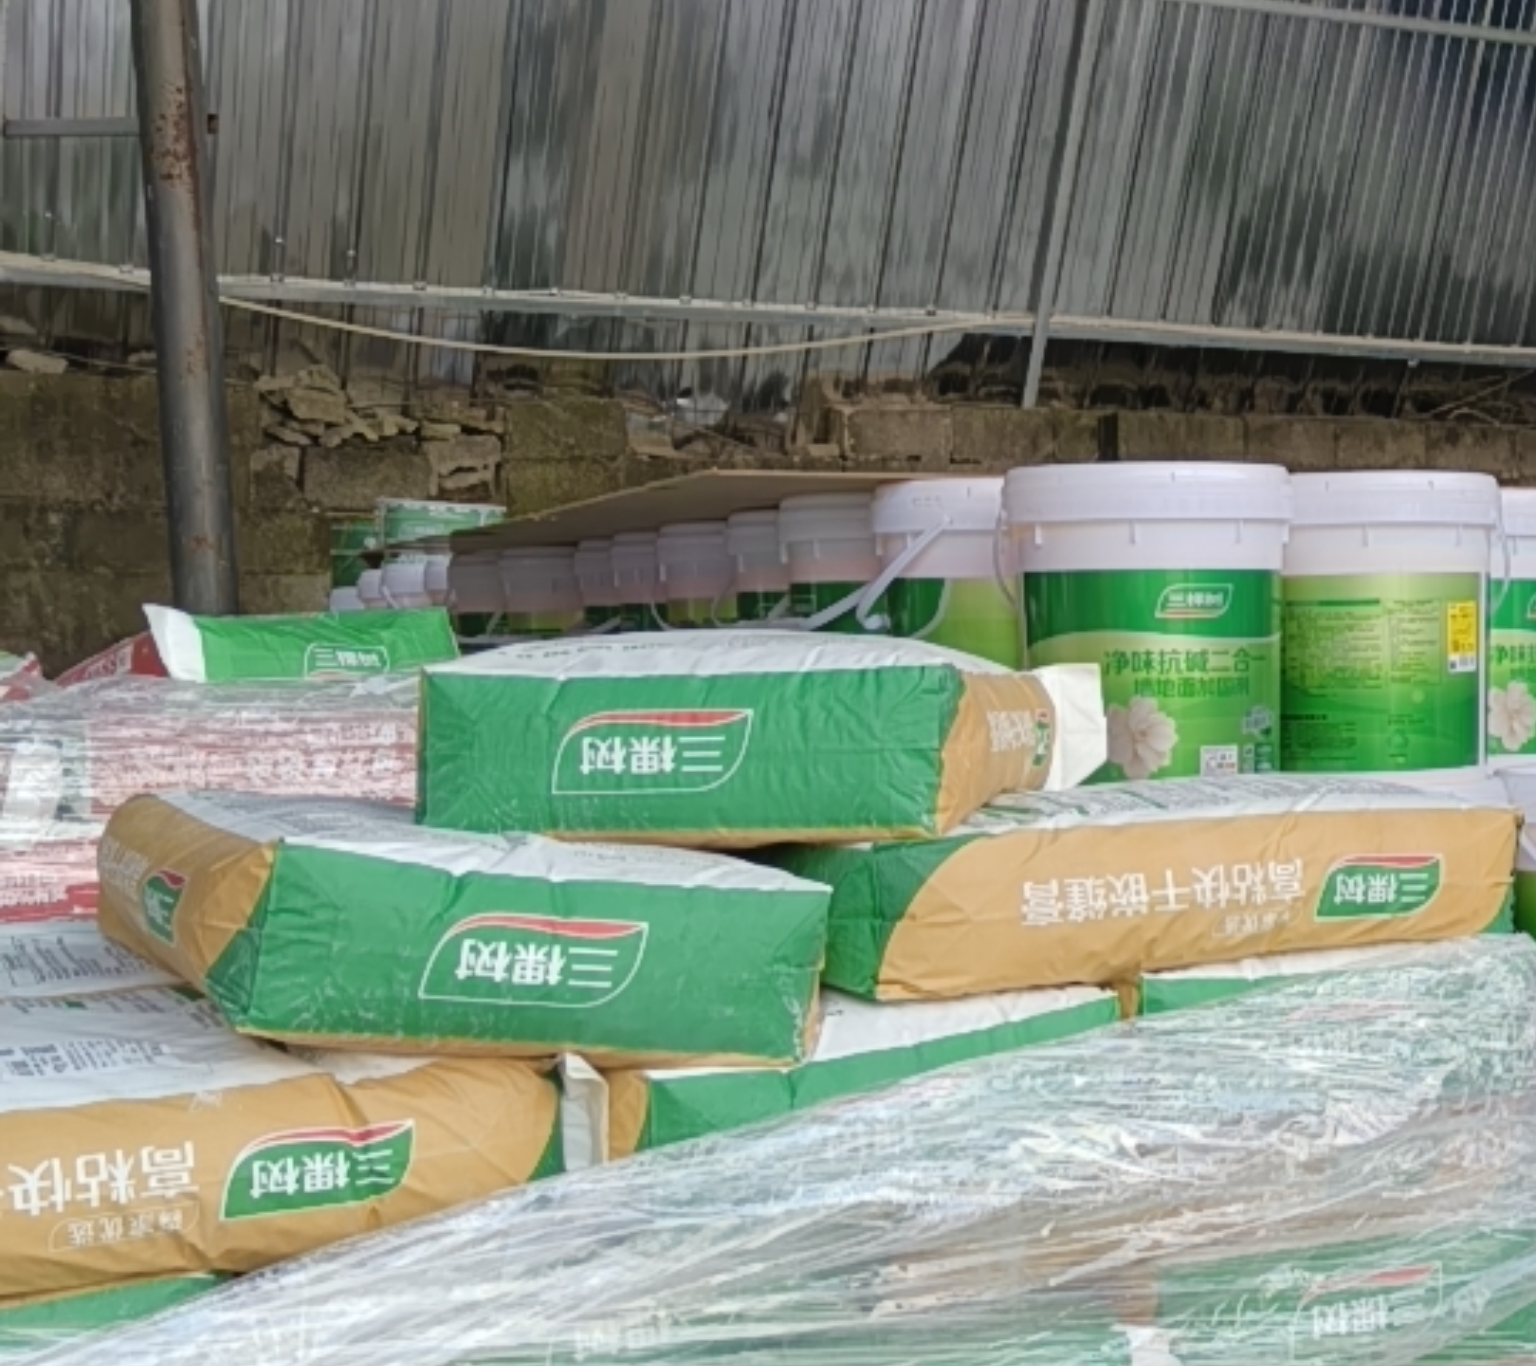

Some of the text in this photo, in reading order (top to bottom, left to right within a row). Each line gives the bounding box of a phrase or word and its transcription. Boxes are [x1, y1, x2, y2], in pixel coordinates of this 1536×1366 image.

[581, 735, 724, 774] 三棵树
[1021, 858, 1303, 927] 高粘快干嵌缝膏
[1335, 873, 1429, 904] 三棵树
[457, 941, 618, 988] 三棵树
[251, 1150, 394, 1198] 三棵树
